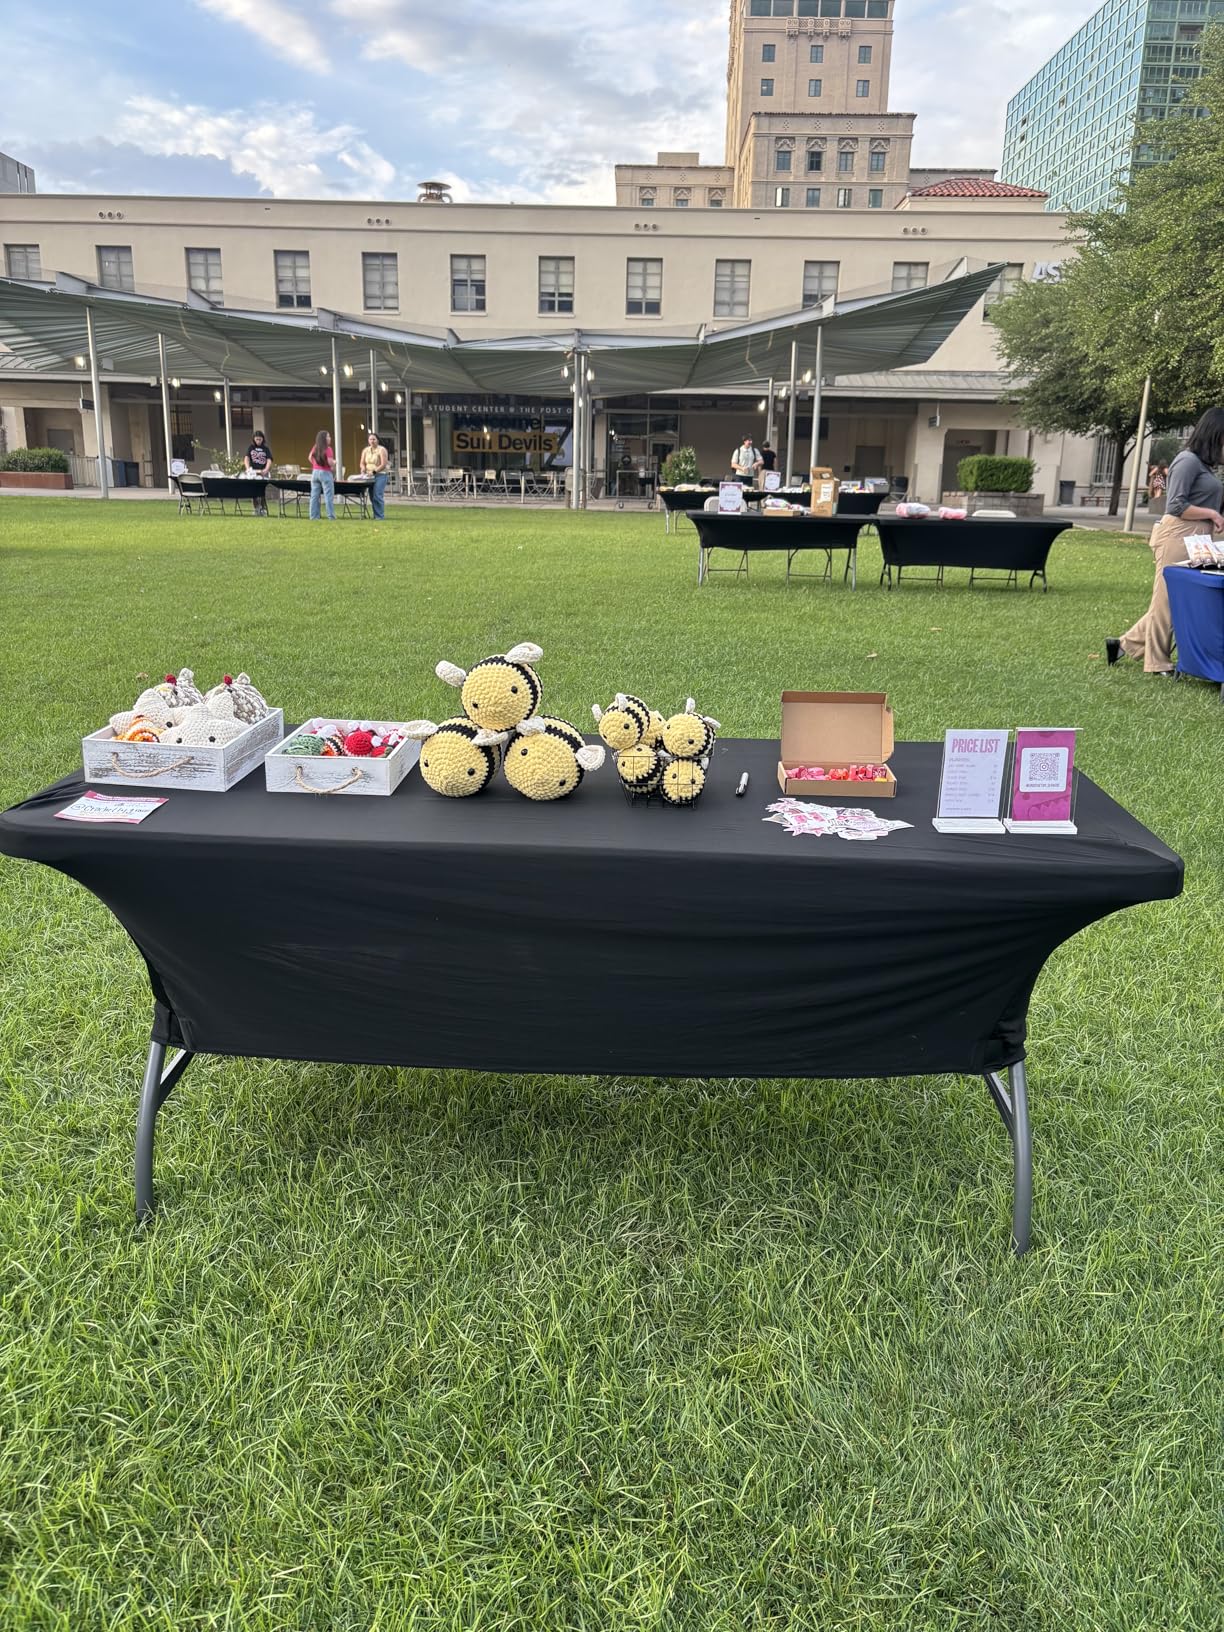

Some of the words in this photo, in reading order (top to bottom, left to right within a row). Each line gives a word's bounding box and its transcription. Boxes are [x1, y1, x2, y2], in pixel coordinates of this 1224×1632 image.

[1032, 262, 1060, 284] AS
[428, 404, 468, 413] STUDENT
[472, 405, 505, 413] CENTER
[540, 407, 562, 415] POST
[456, 433, 492, 450] Sun
[498, 434, 553, 451] Devils
[951, 738, 978, 753] PRICE
[979, 738, 1000, 753] LIST
